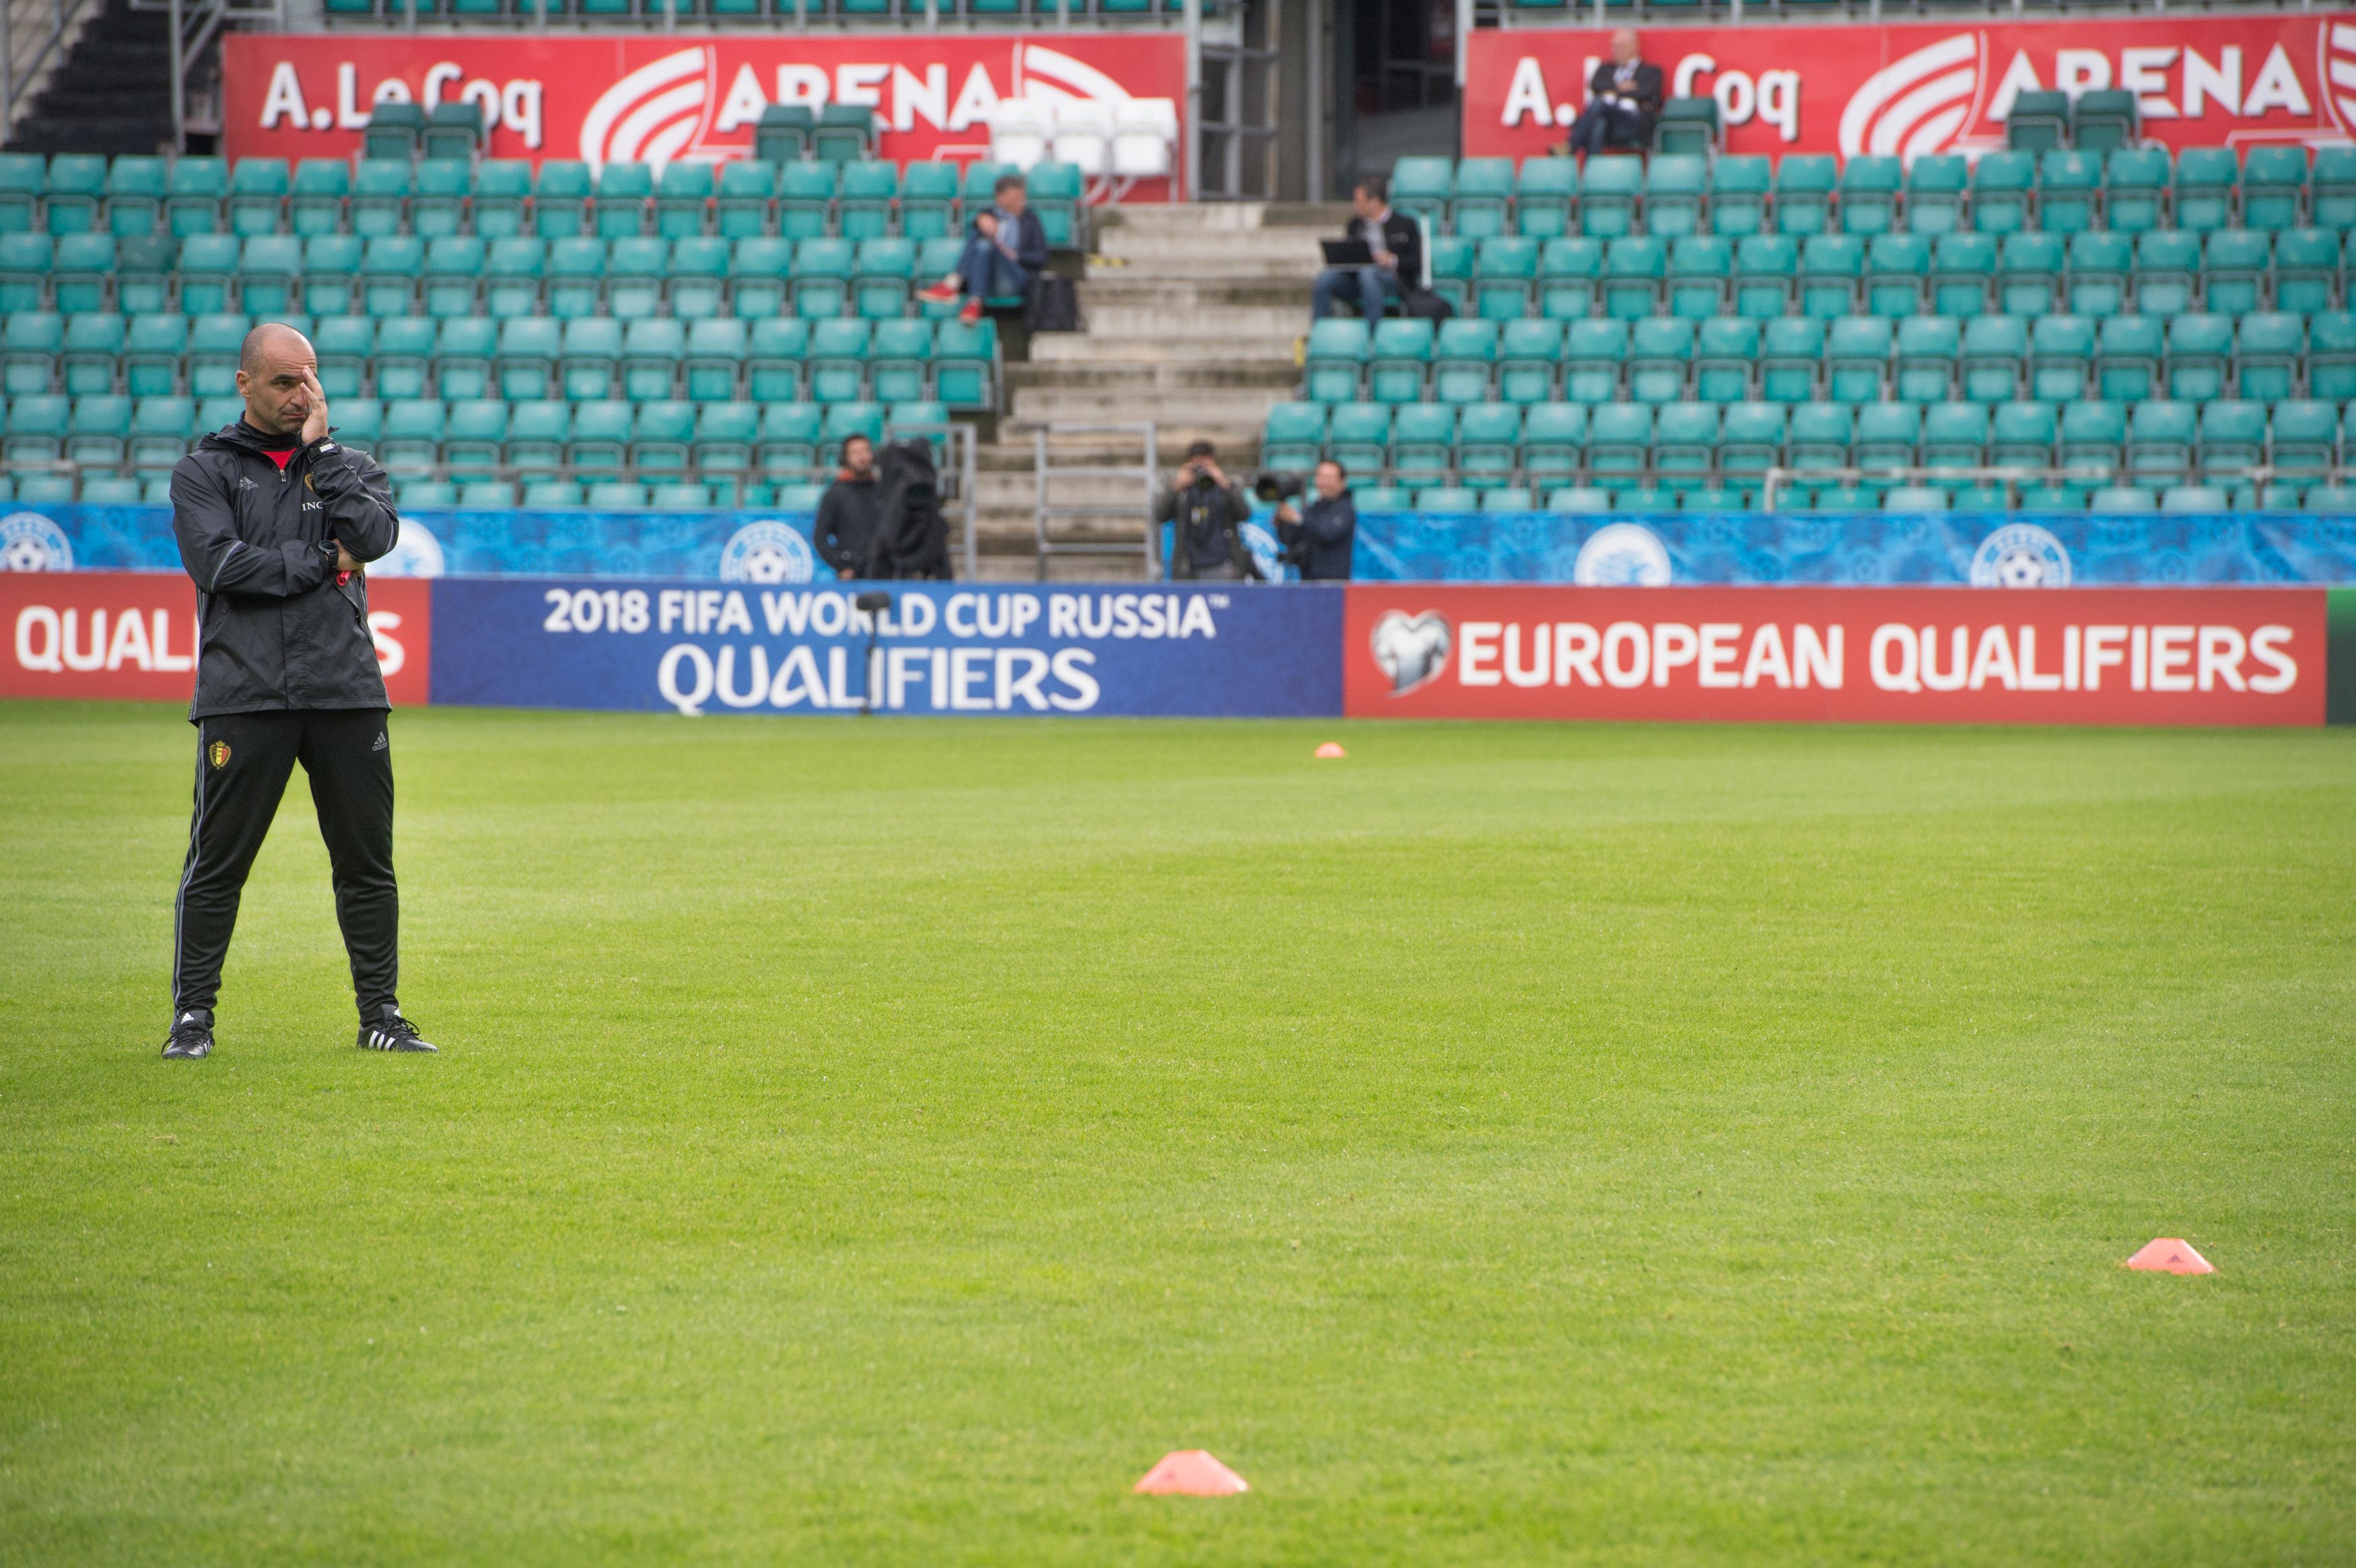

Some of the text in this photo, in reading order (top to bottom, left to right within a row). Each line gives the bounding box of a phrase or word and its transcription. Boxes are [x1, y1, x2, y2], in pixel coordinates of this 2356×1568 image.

[1986, 42, 2312, 122] ARENA
[543, 589, 650, 633] 2018
[659, 590, 754, 635] FIFA
[761, 592, 937, 638] WORLD
[944, 593, 1041, 639] CUP
[657, 643, 1101, 717] QUALIFIERS
[1459, 620, 2298, 694] EUROPEAN QUALIFIERS
